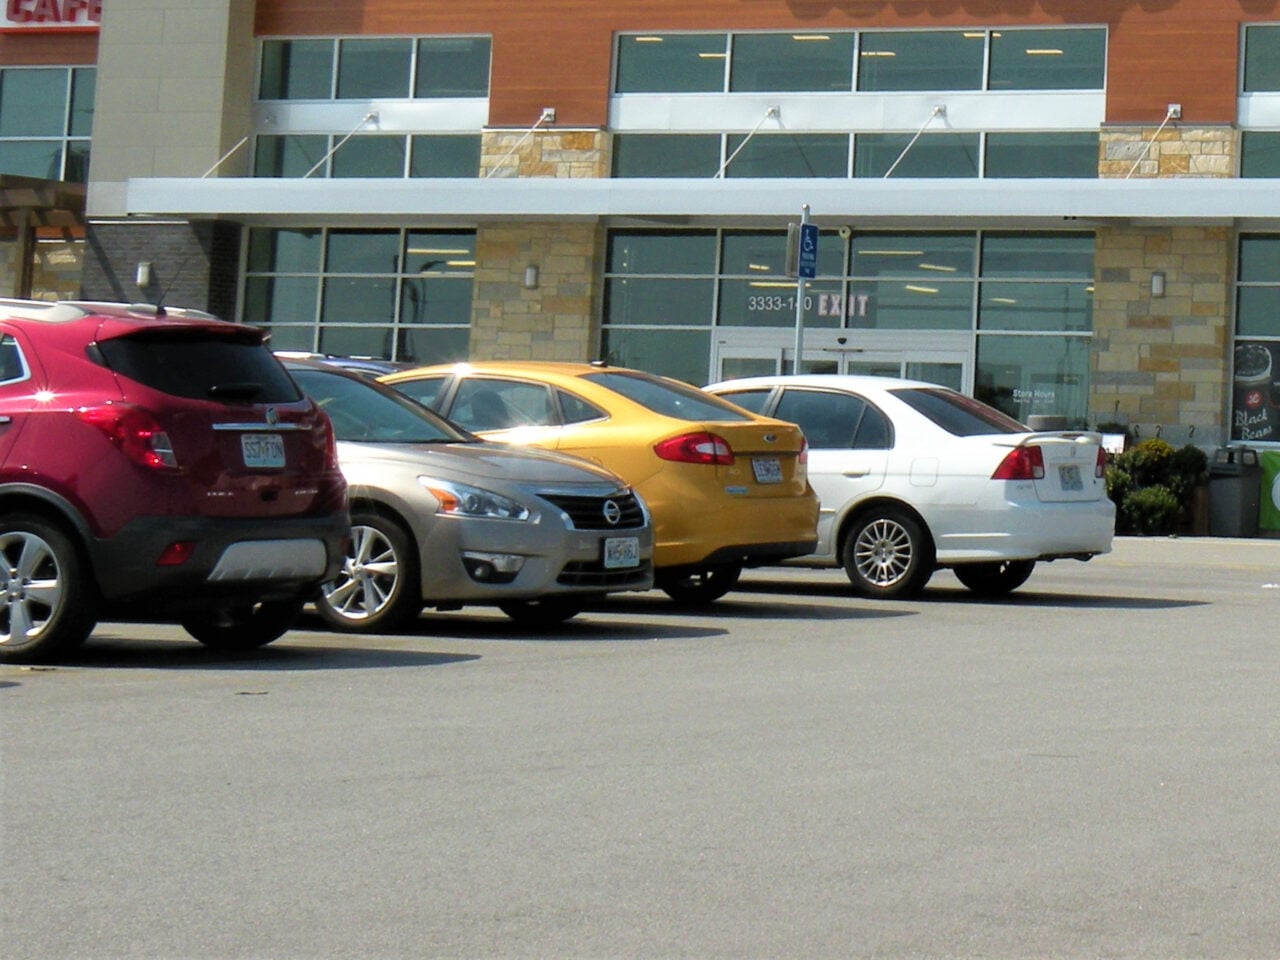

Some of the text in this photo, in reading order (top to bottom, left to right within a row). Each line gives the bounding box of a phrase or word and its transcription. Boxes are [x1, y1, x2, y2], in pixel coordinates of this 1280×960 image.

[748, 296, 812, 311] 3333-10
[817, 293, 869, 317] EXIT
[1235, 408, 1269, 426] Black
[1241, 425, 1273, 441] Beans
